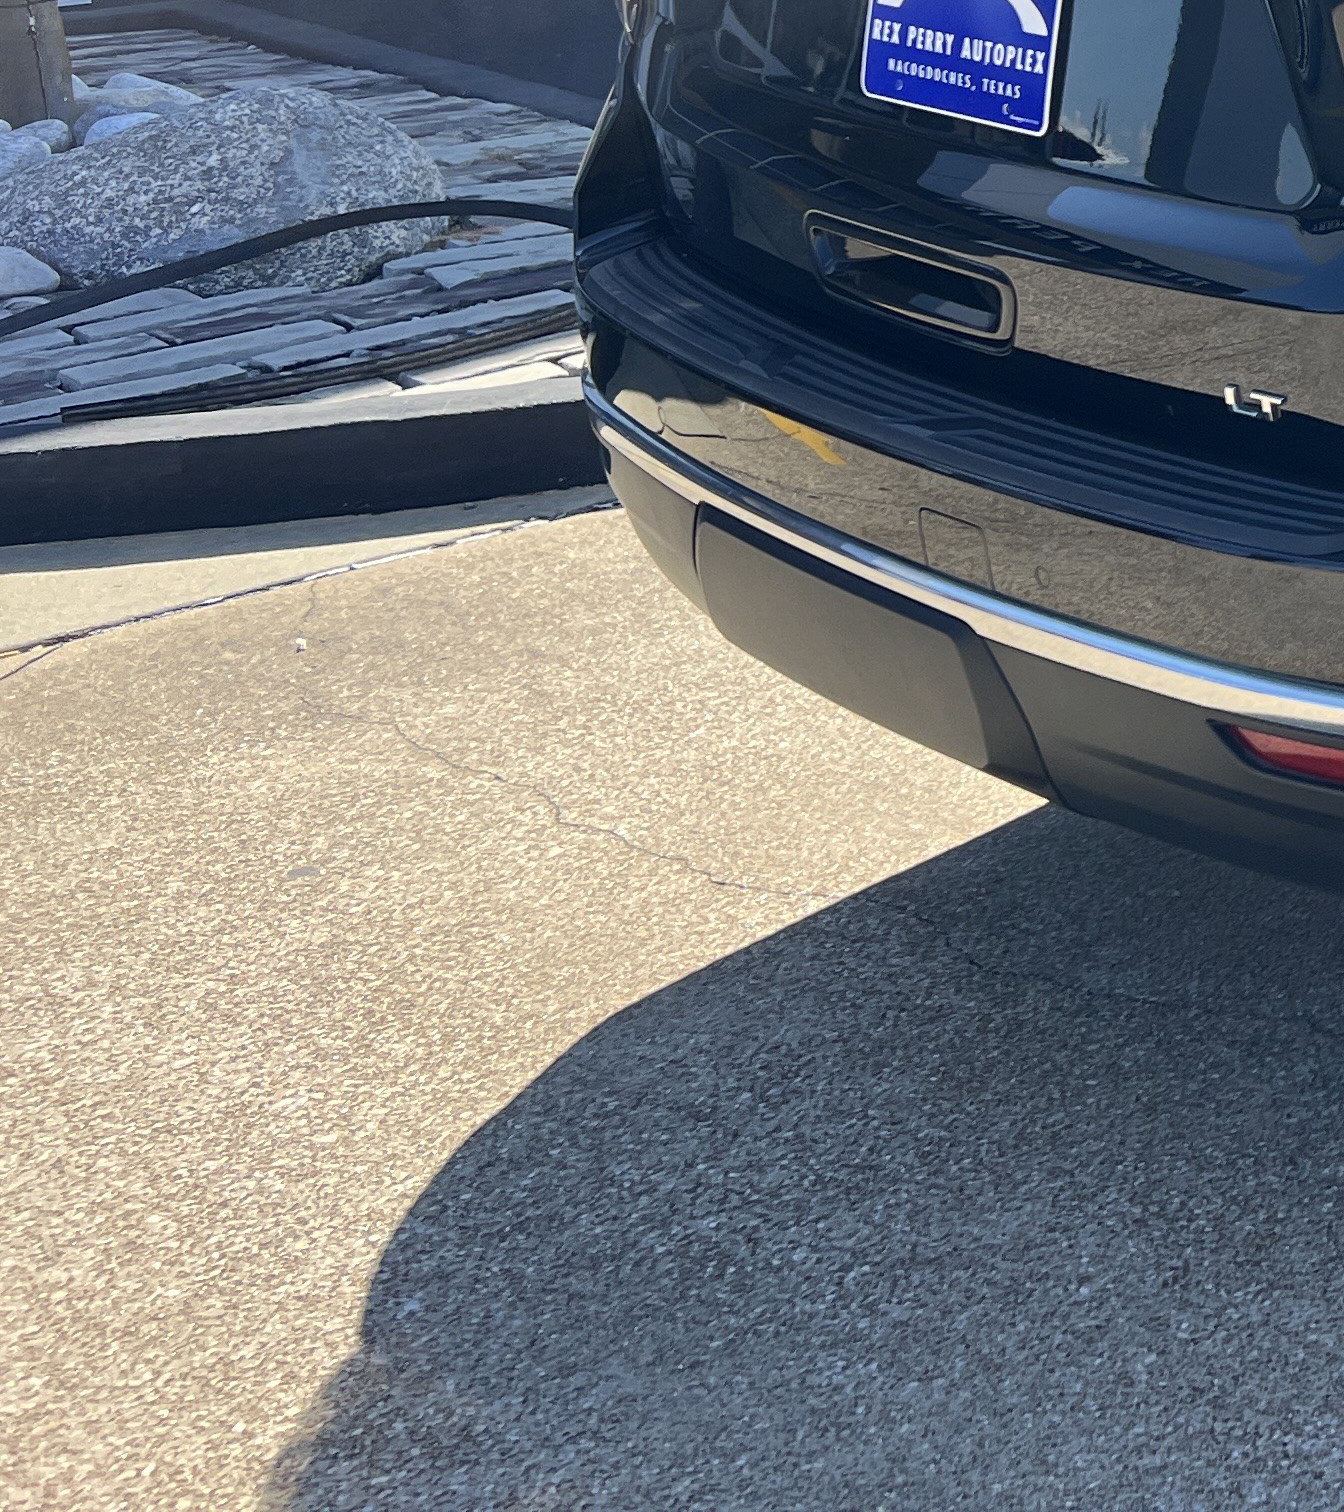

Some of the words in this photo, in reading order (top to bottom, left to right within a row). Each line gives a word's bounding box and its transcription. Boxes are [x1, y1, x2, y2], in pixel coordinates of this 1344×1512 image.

[871, 18, 902, 44] REX
[906, 25, 955, 55] PERRY
[960, 37, 1046, 74] AUTOPLEX
[887, 58, 977, 91] NACOGDOCHES,
[982, 78, 1021, 99] TEXAS
[1223, 383, 1287, 422] LT
